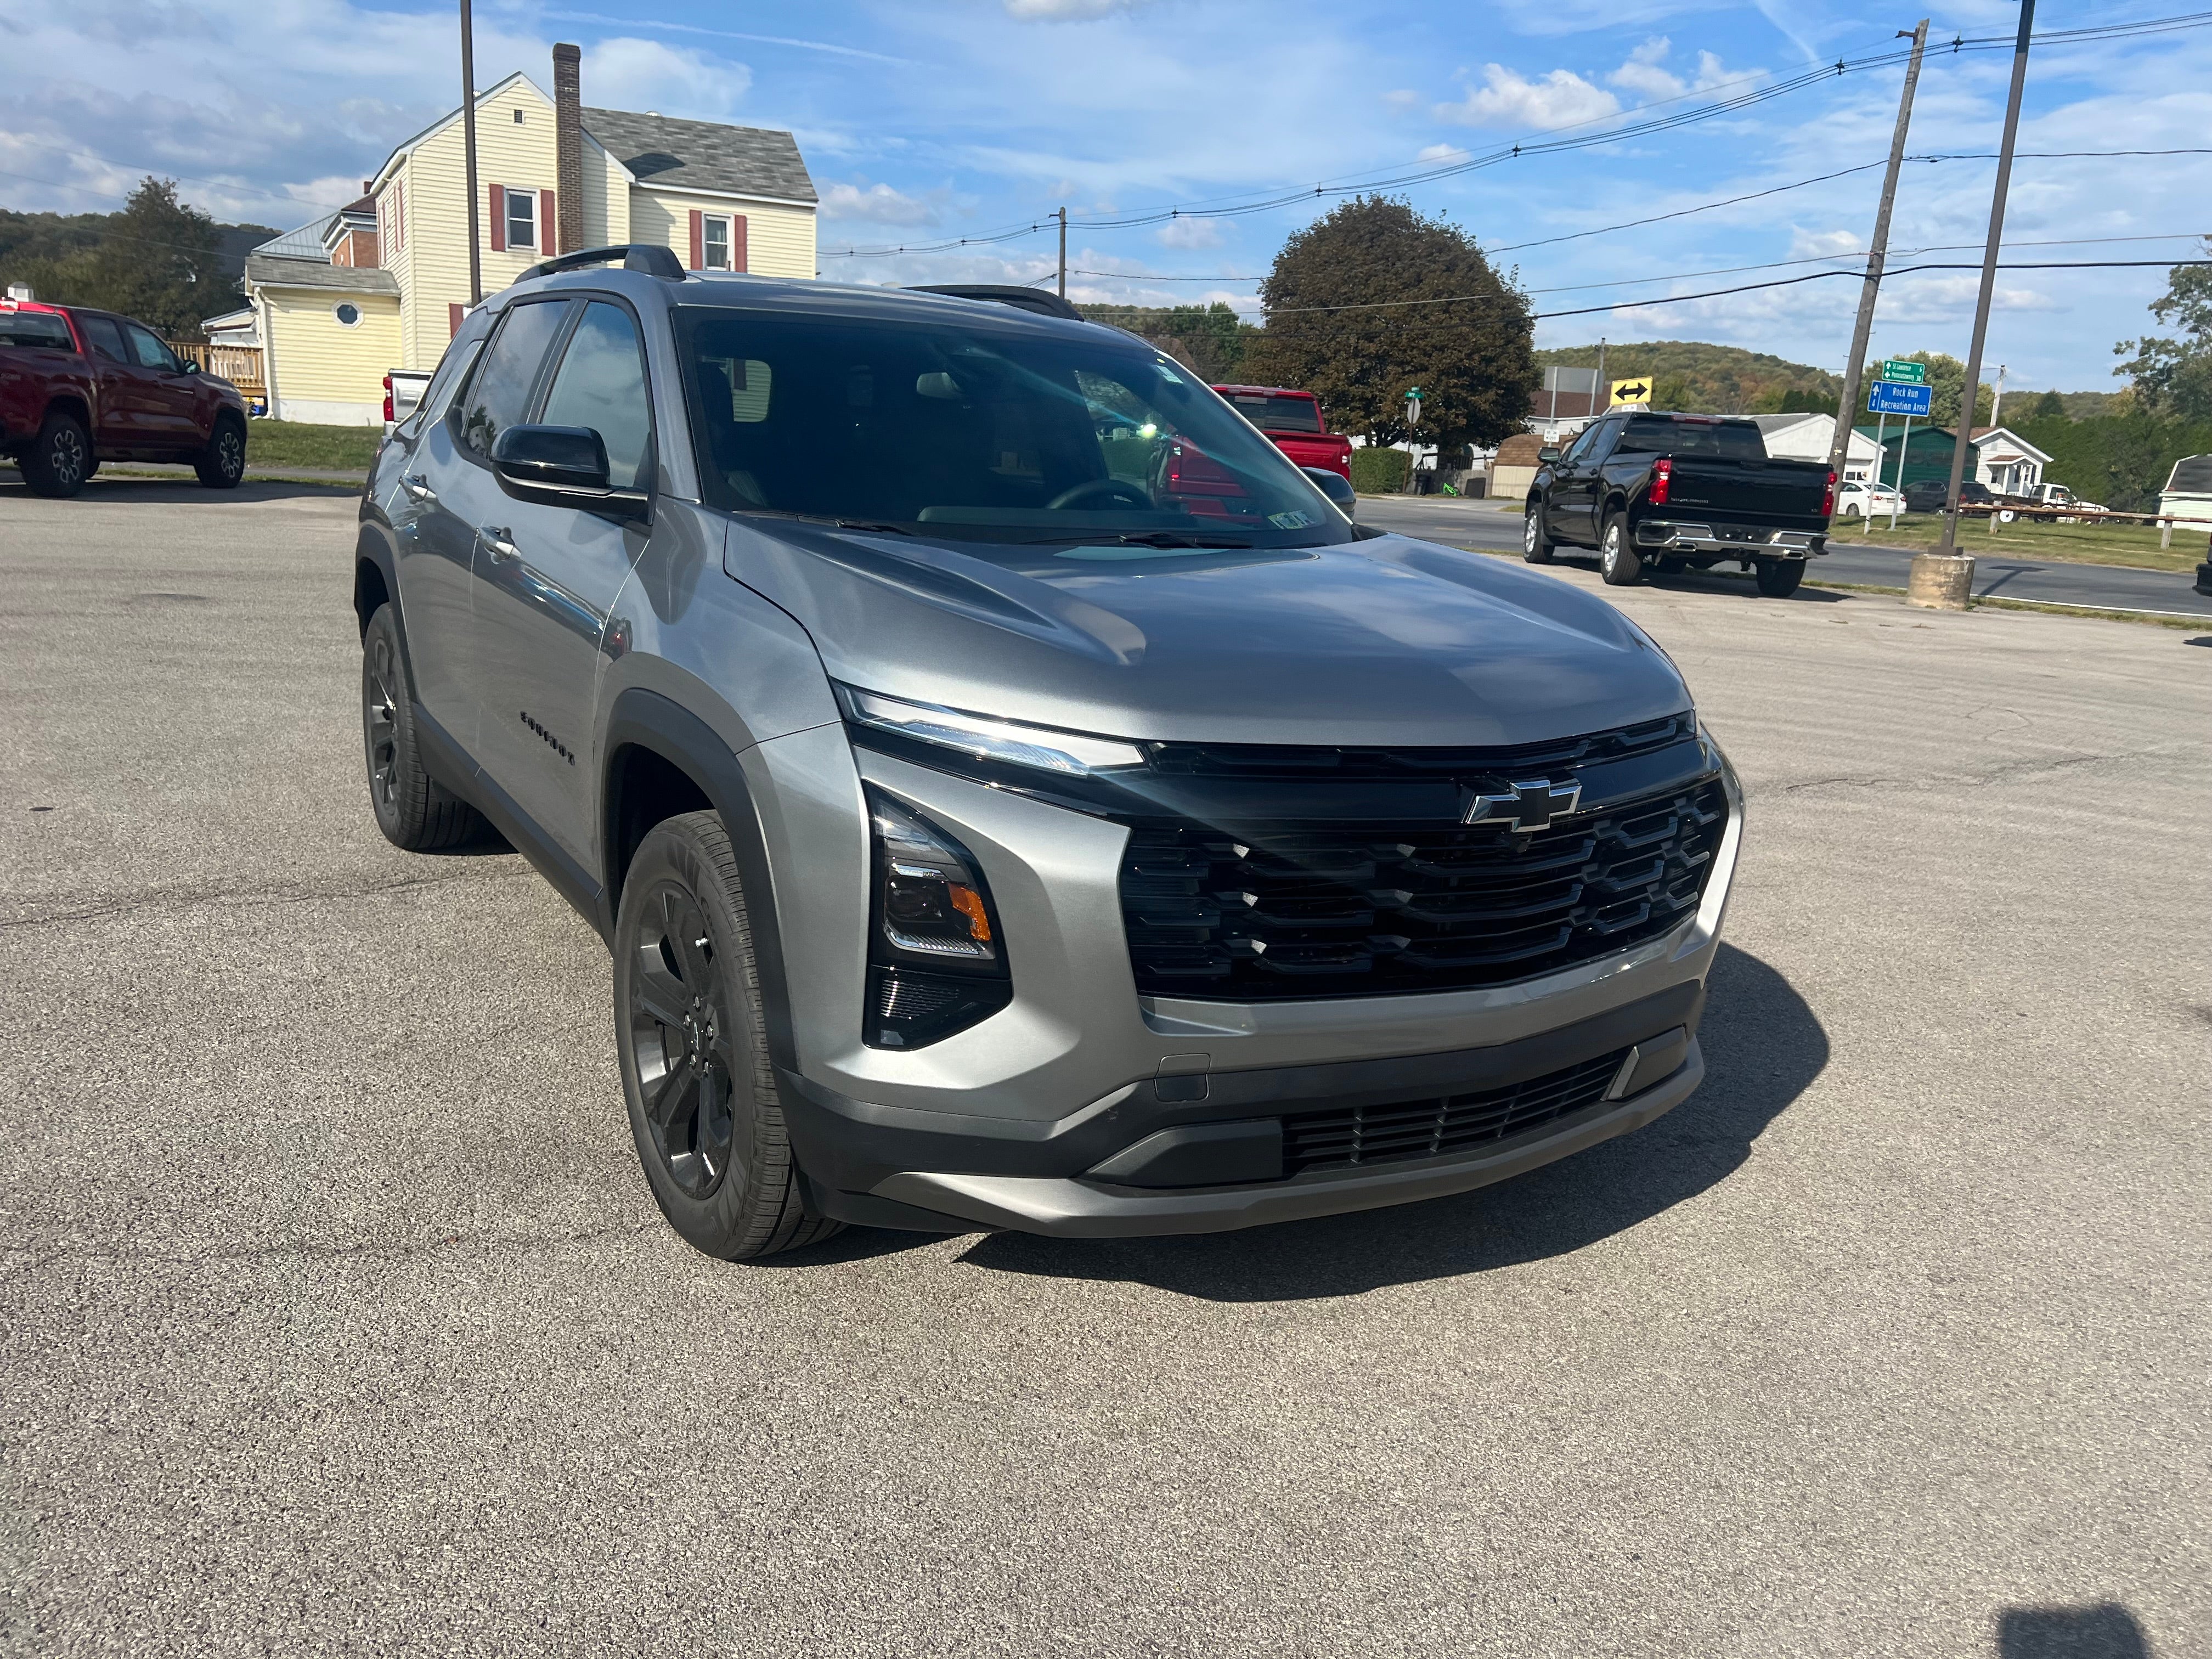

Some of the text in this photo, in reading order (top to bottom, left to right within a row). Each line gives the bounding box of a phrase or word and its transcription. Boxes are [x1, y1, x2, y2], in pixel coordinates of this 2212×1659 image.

[1892, 387, 1919, 398] Rock Run
[1871, 399, 1876, 407] 4
[1880, 399, 1926, 412] Recreation Area
